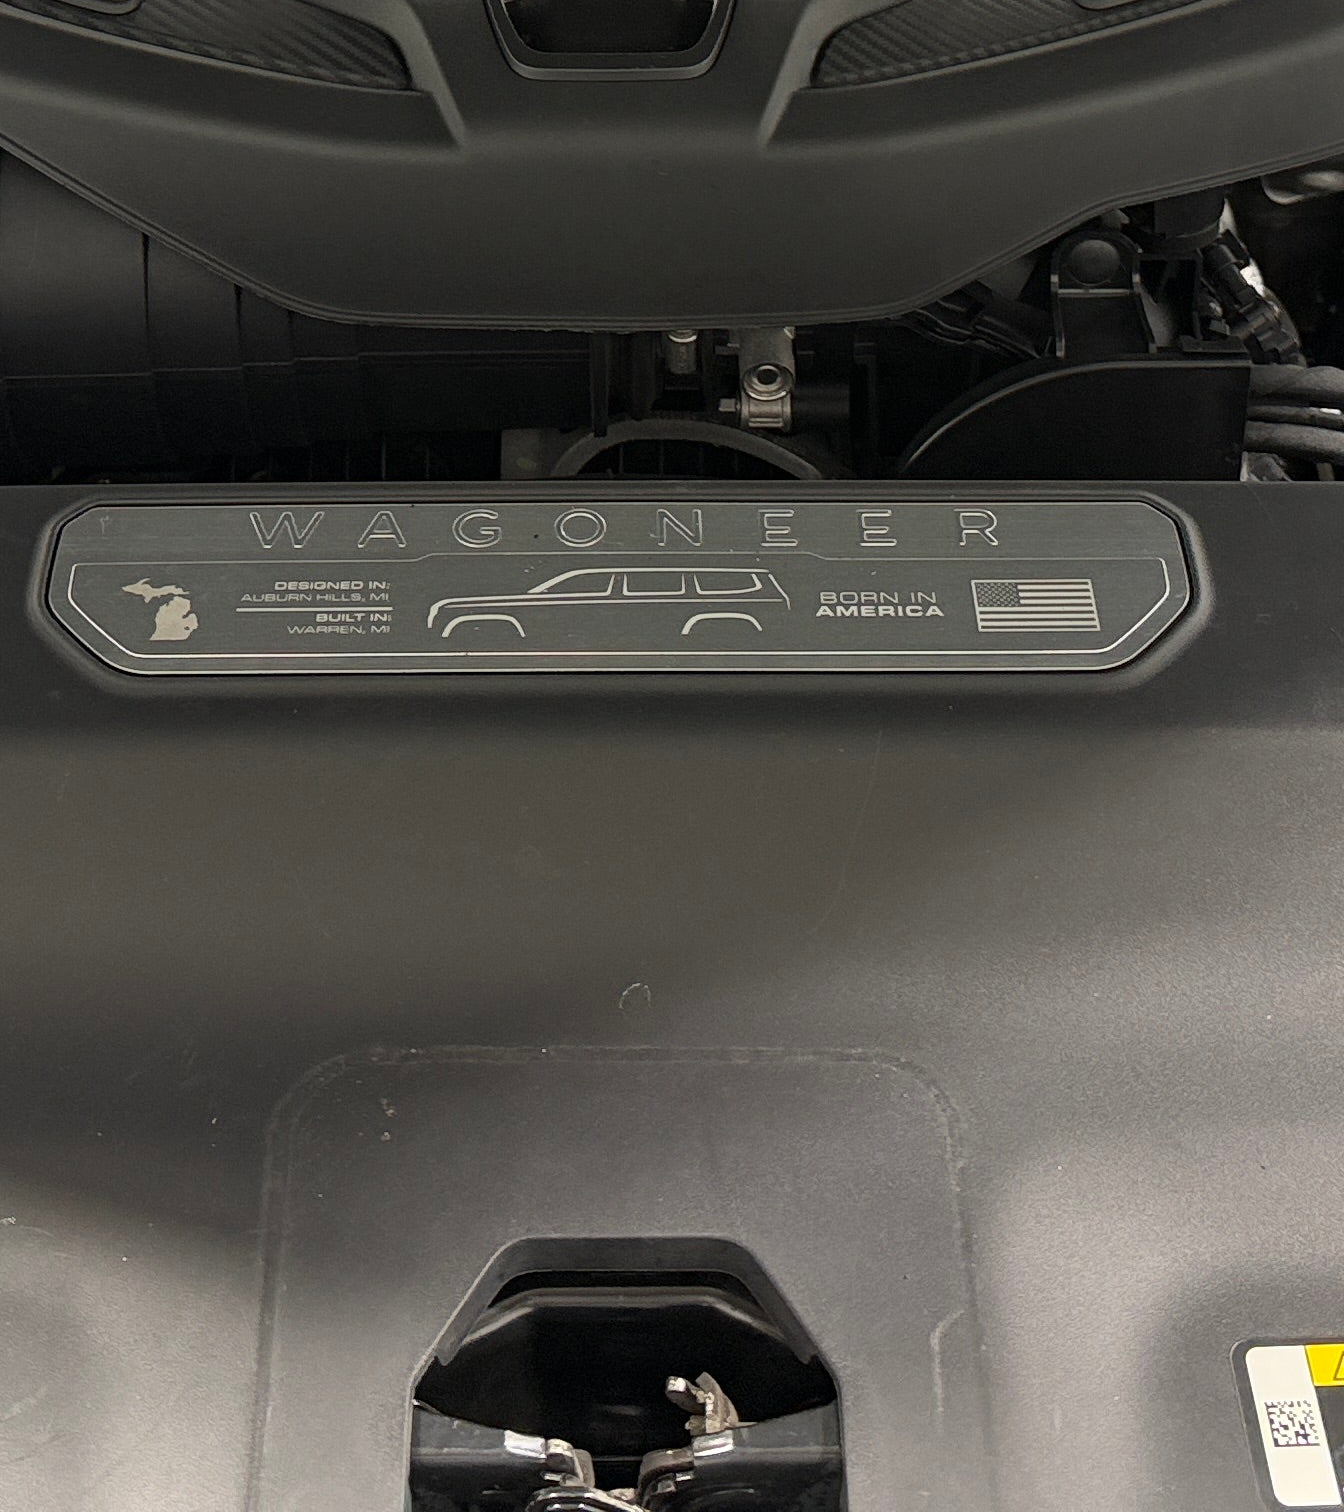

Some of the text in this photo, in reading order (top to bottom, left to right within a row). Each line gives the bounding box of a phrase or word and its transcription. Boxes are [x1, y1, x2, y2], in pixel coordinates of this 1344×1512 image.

[249, 508, 999, 549] WAGONEER
[274, 580, 364, 591] DESIGNED
[240, 592, 312, 602] AUBURN
[316, 592, 365, 603] HILLS,
[819, 591, 937, 604] BORN IN
[815, 605, 945, 617] AMERICA
[315, 613, 366, 623] BUILT
[287, 625, 366, 635] WARREN,
